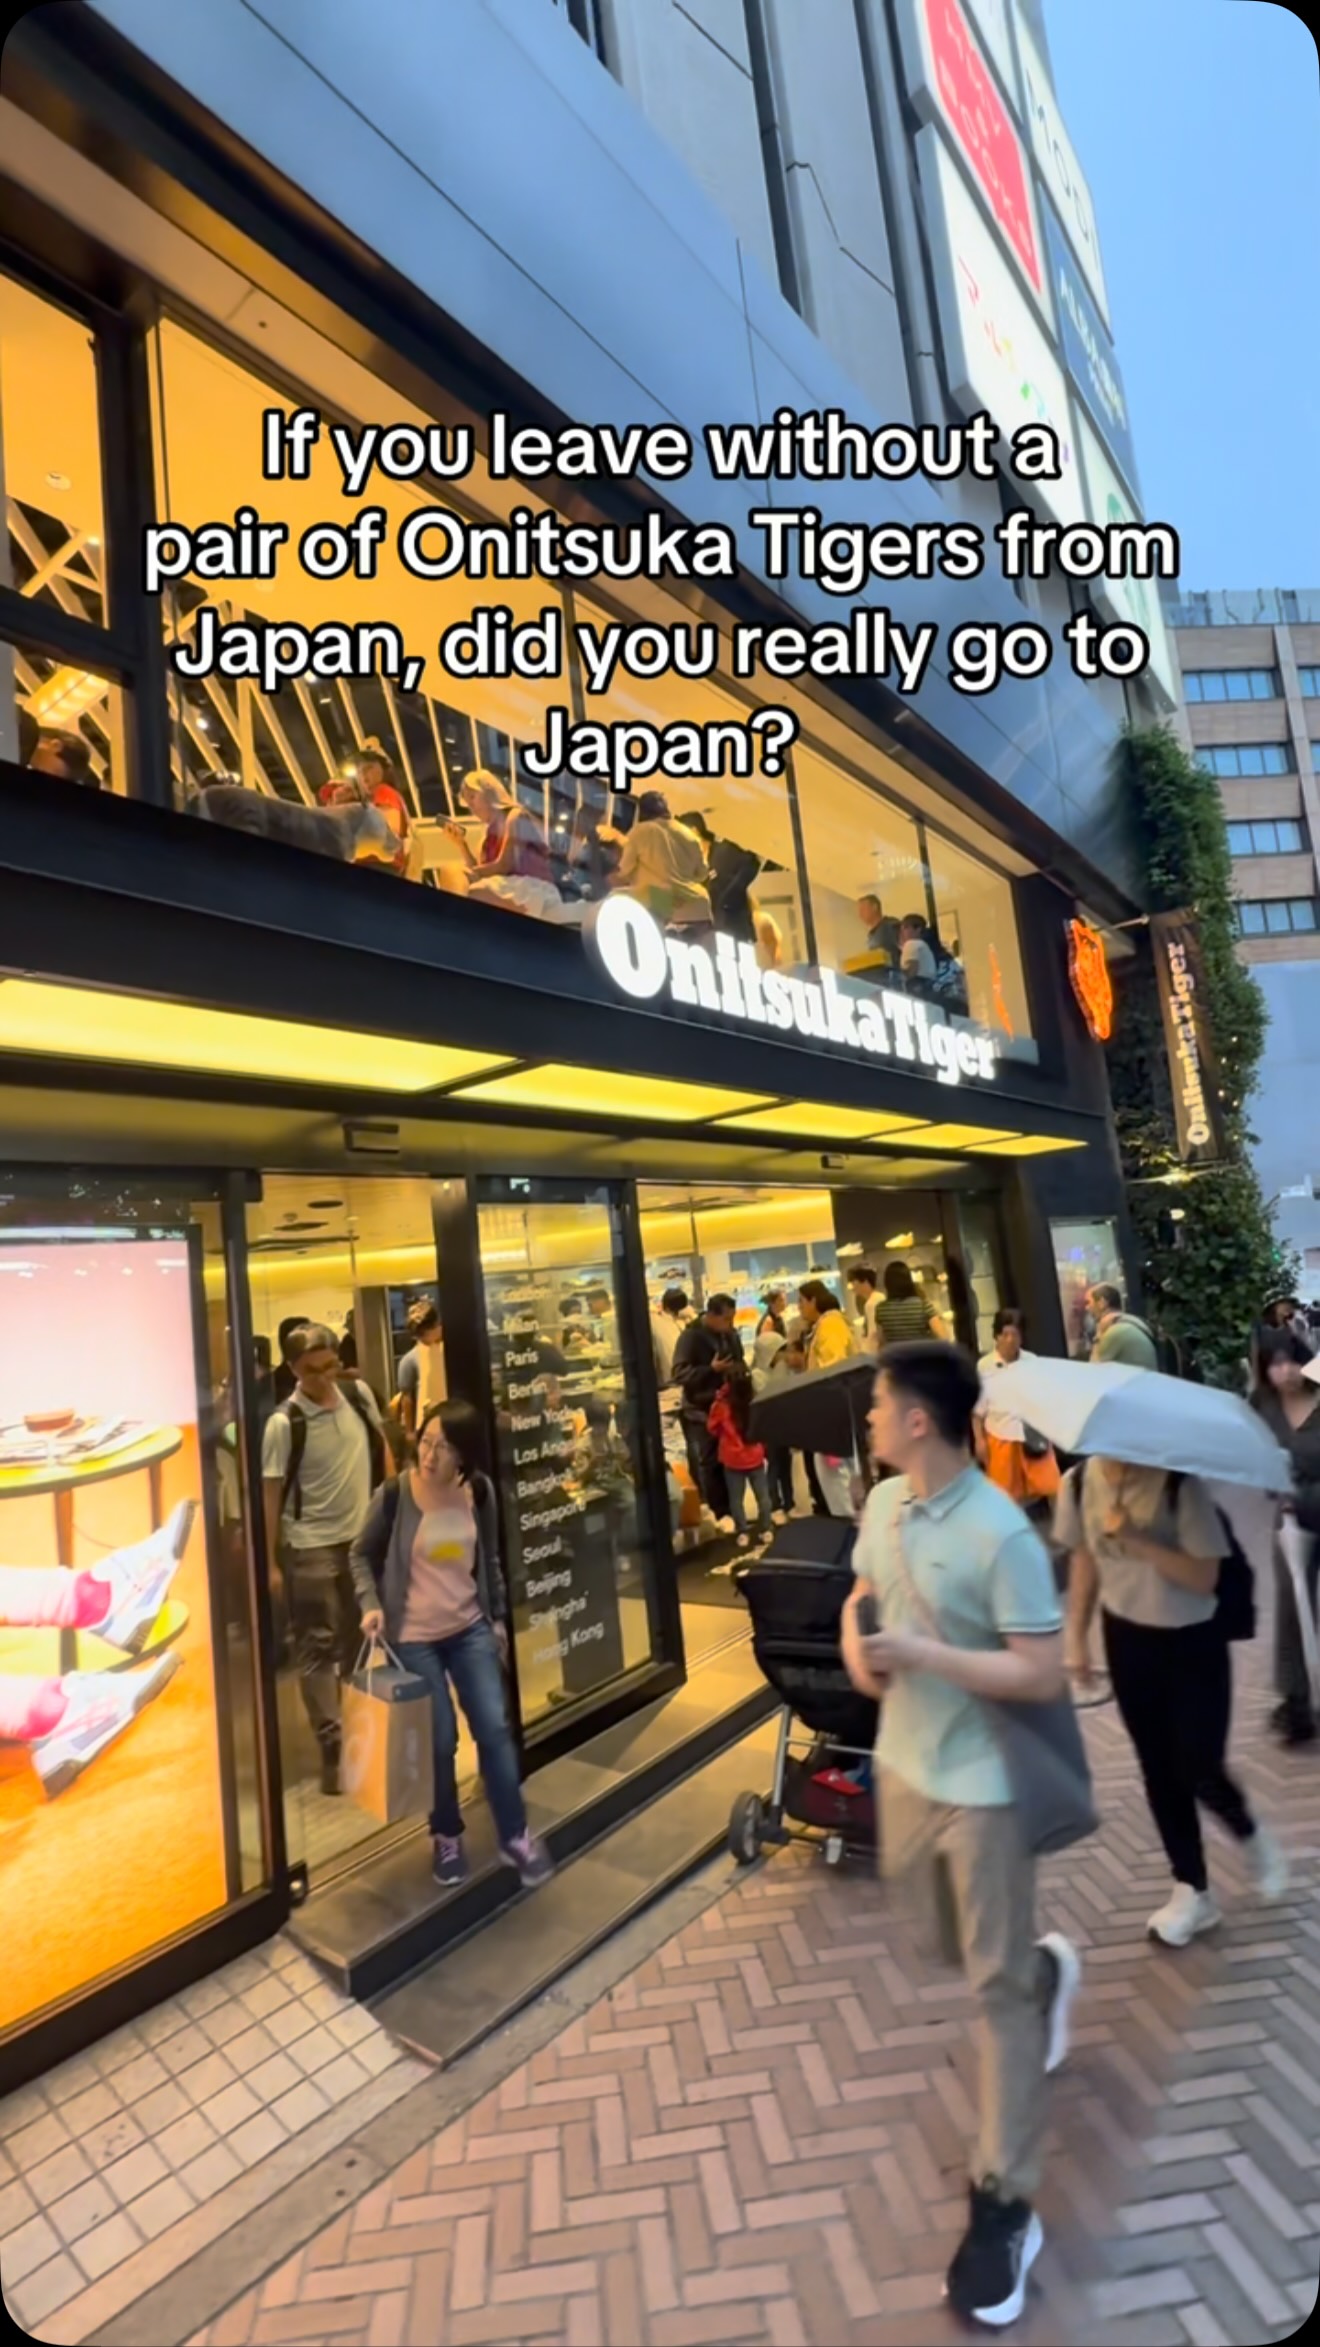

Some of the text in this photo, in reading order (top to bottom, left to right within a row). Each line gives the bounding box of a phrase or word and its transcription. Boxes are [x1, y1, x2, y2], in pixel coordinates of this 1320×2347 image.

[505, 1348, 539, 1367] Paris
[508, 1380, 548, 1400] Berlin
[511, 1414, 542, 1433] New
[513, 1446, 538, 1466] Los
[522, 1535, 562, 1565] Seoul
[525, 1569, 572, 1598] Beijing
[570, 1621, 605, 1649] Kong
